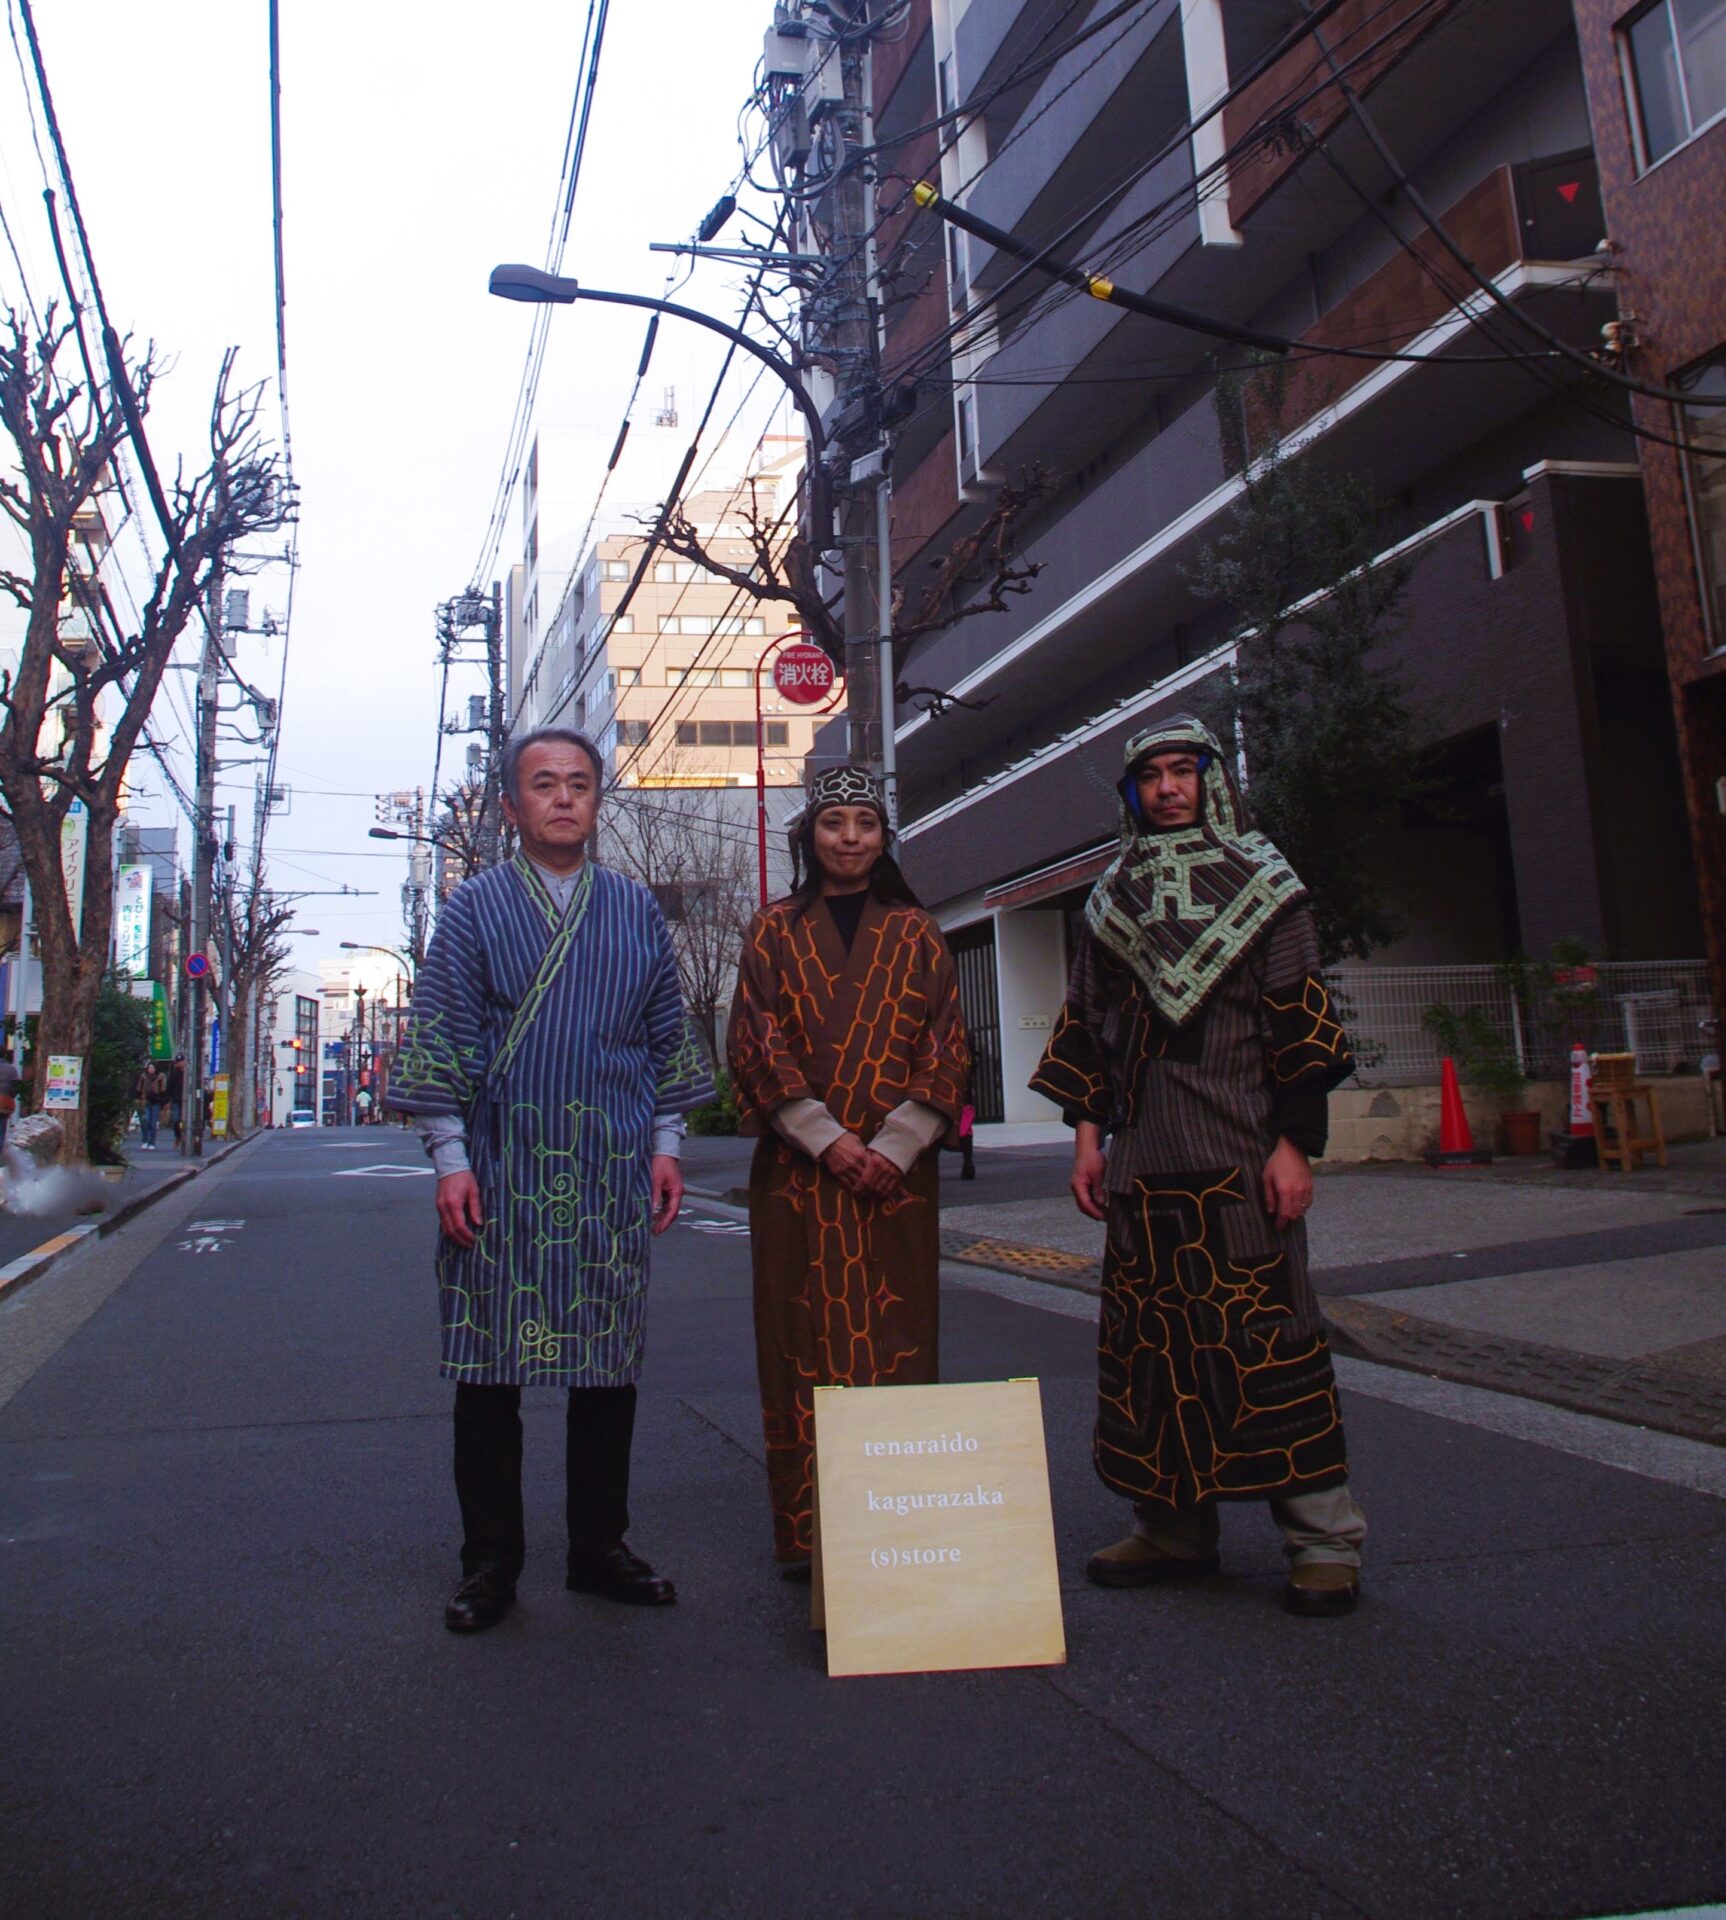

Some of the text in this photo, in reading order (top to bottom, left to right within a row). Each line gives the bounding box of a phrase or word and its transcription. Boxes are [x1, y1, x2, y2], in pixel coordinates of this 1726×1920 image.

[779, 662, 830, 686] 消火栓
[863, 1432, 979, 1457] tenaraido
[867, 1484, 1004, 1516] kagurazaka
[870, 1546, 962, 1569] (s)store
